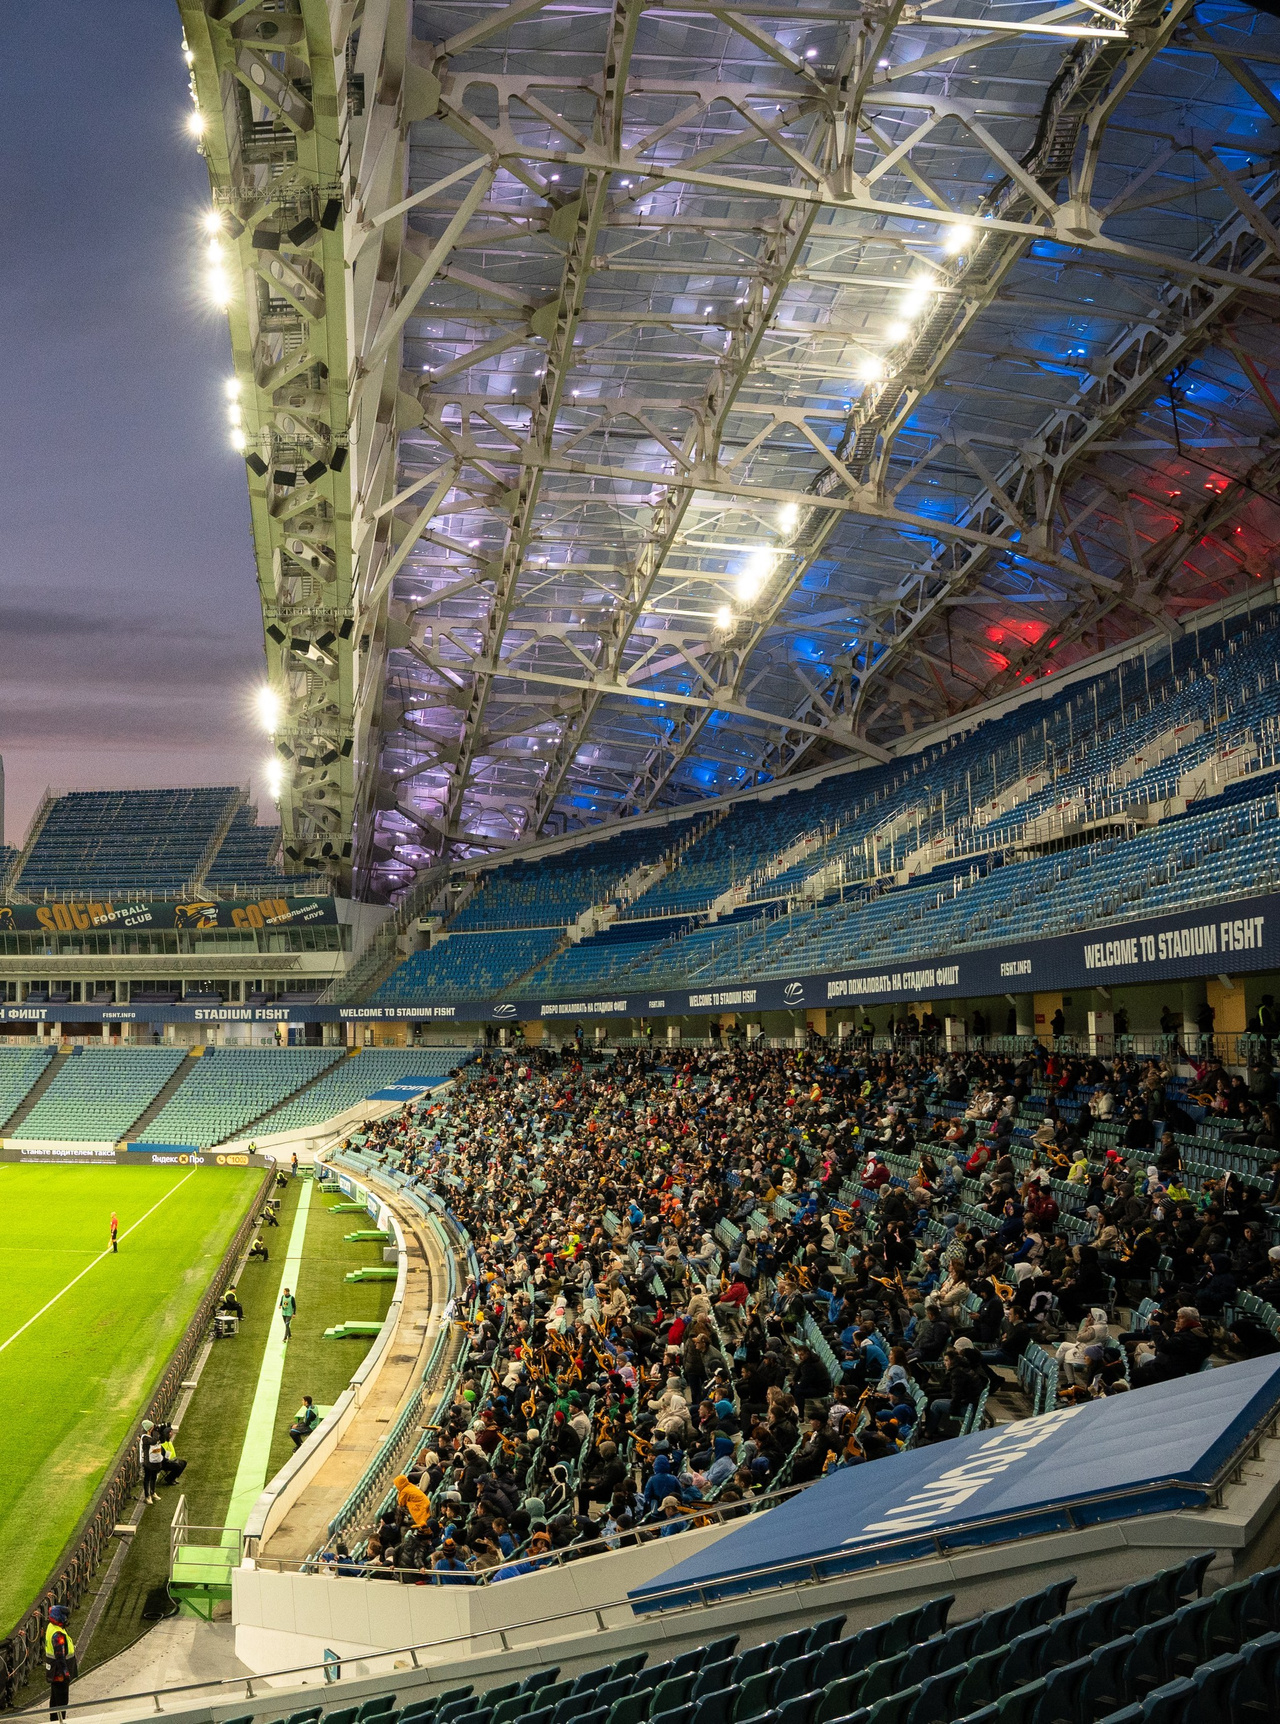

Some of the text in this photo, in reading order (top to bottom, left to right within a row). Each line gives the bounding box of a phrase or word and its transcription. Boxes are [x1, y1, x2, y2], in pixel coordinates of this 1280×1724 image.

[35, 903, 117, 930] SOCHI
[93, 904, 148, 925] FOOTBALL
[124, 913, 152, 926] CLUB
[231, 899, 293, 928] СОЧИ
[266, 902, 318, 924] ФУТБОЛЬНЫЙ
[304, 910, 325, 921] КЛУБ
[1084, 916, 1264, 969] WELCOME TO STADIUM FISHT
[1000, 959, 1032, 976] FISHT.INFO
[827, 965, 959, 999] ДОБРО ПОЖАЛОВАТЬ НА СТАДИОН ФИШТ
[689, 989, 757, 1007] WELCOME TO STADIUM FISHT
[8, 1008, 48, 1019] ФИШТ
[194, 1009, 290, 1020] STADIUM FISHT
[340, 1007, 455, 1017] WELCOME TO STADIUM FISHT
[152, 1154, 205, 1164] Яндекс Про
